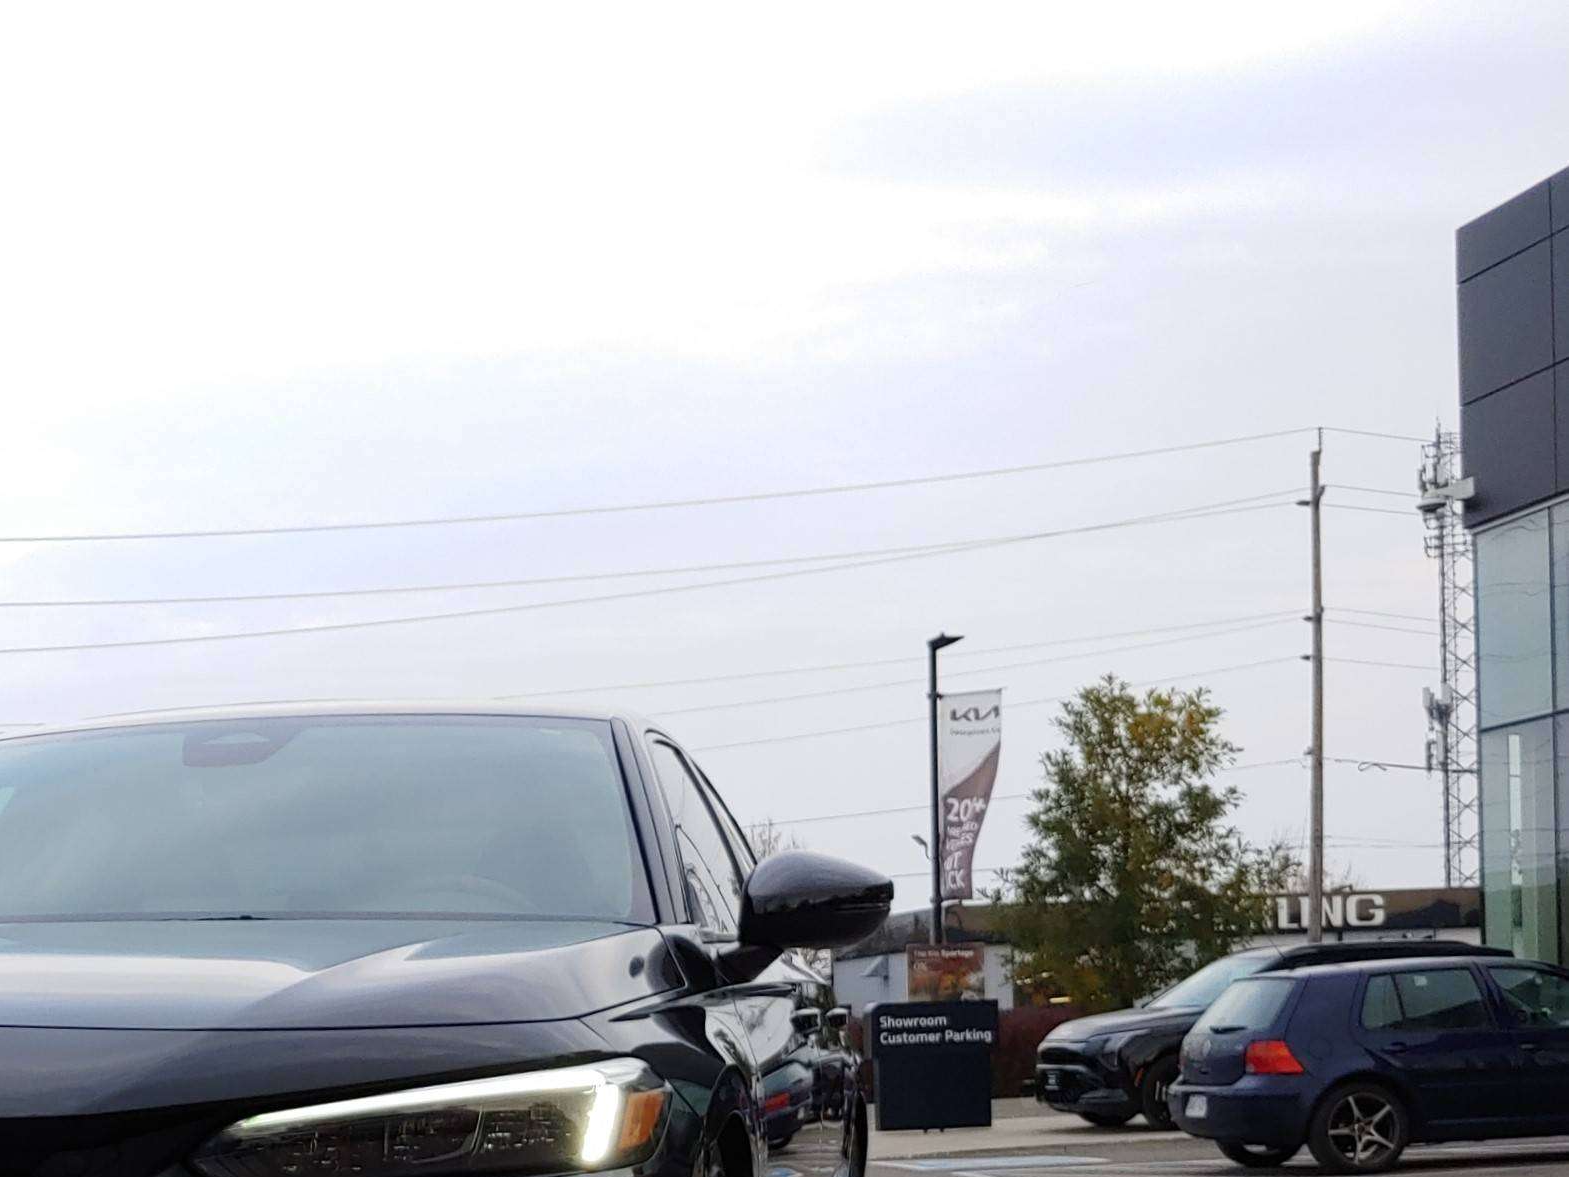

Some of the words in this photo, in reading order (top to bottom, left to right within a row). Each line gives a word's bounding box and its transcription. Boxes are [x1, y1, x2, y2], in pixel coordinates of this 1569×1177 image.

[879, 1016, 948, 1028] Showroom
[879, 1031, 942, 1045] Customer
[944, 1028, 993, 1044] Parking
